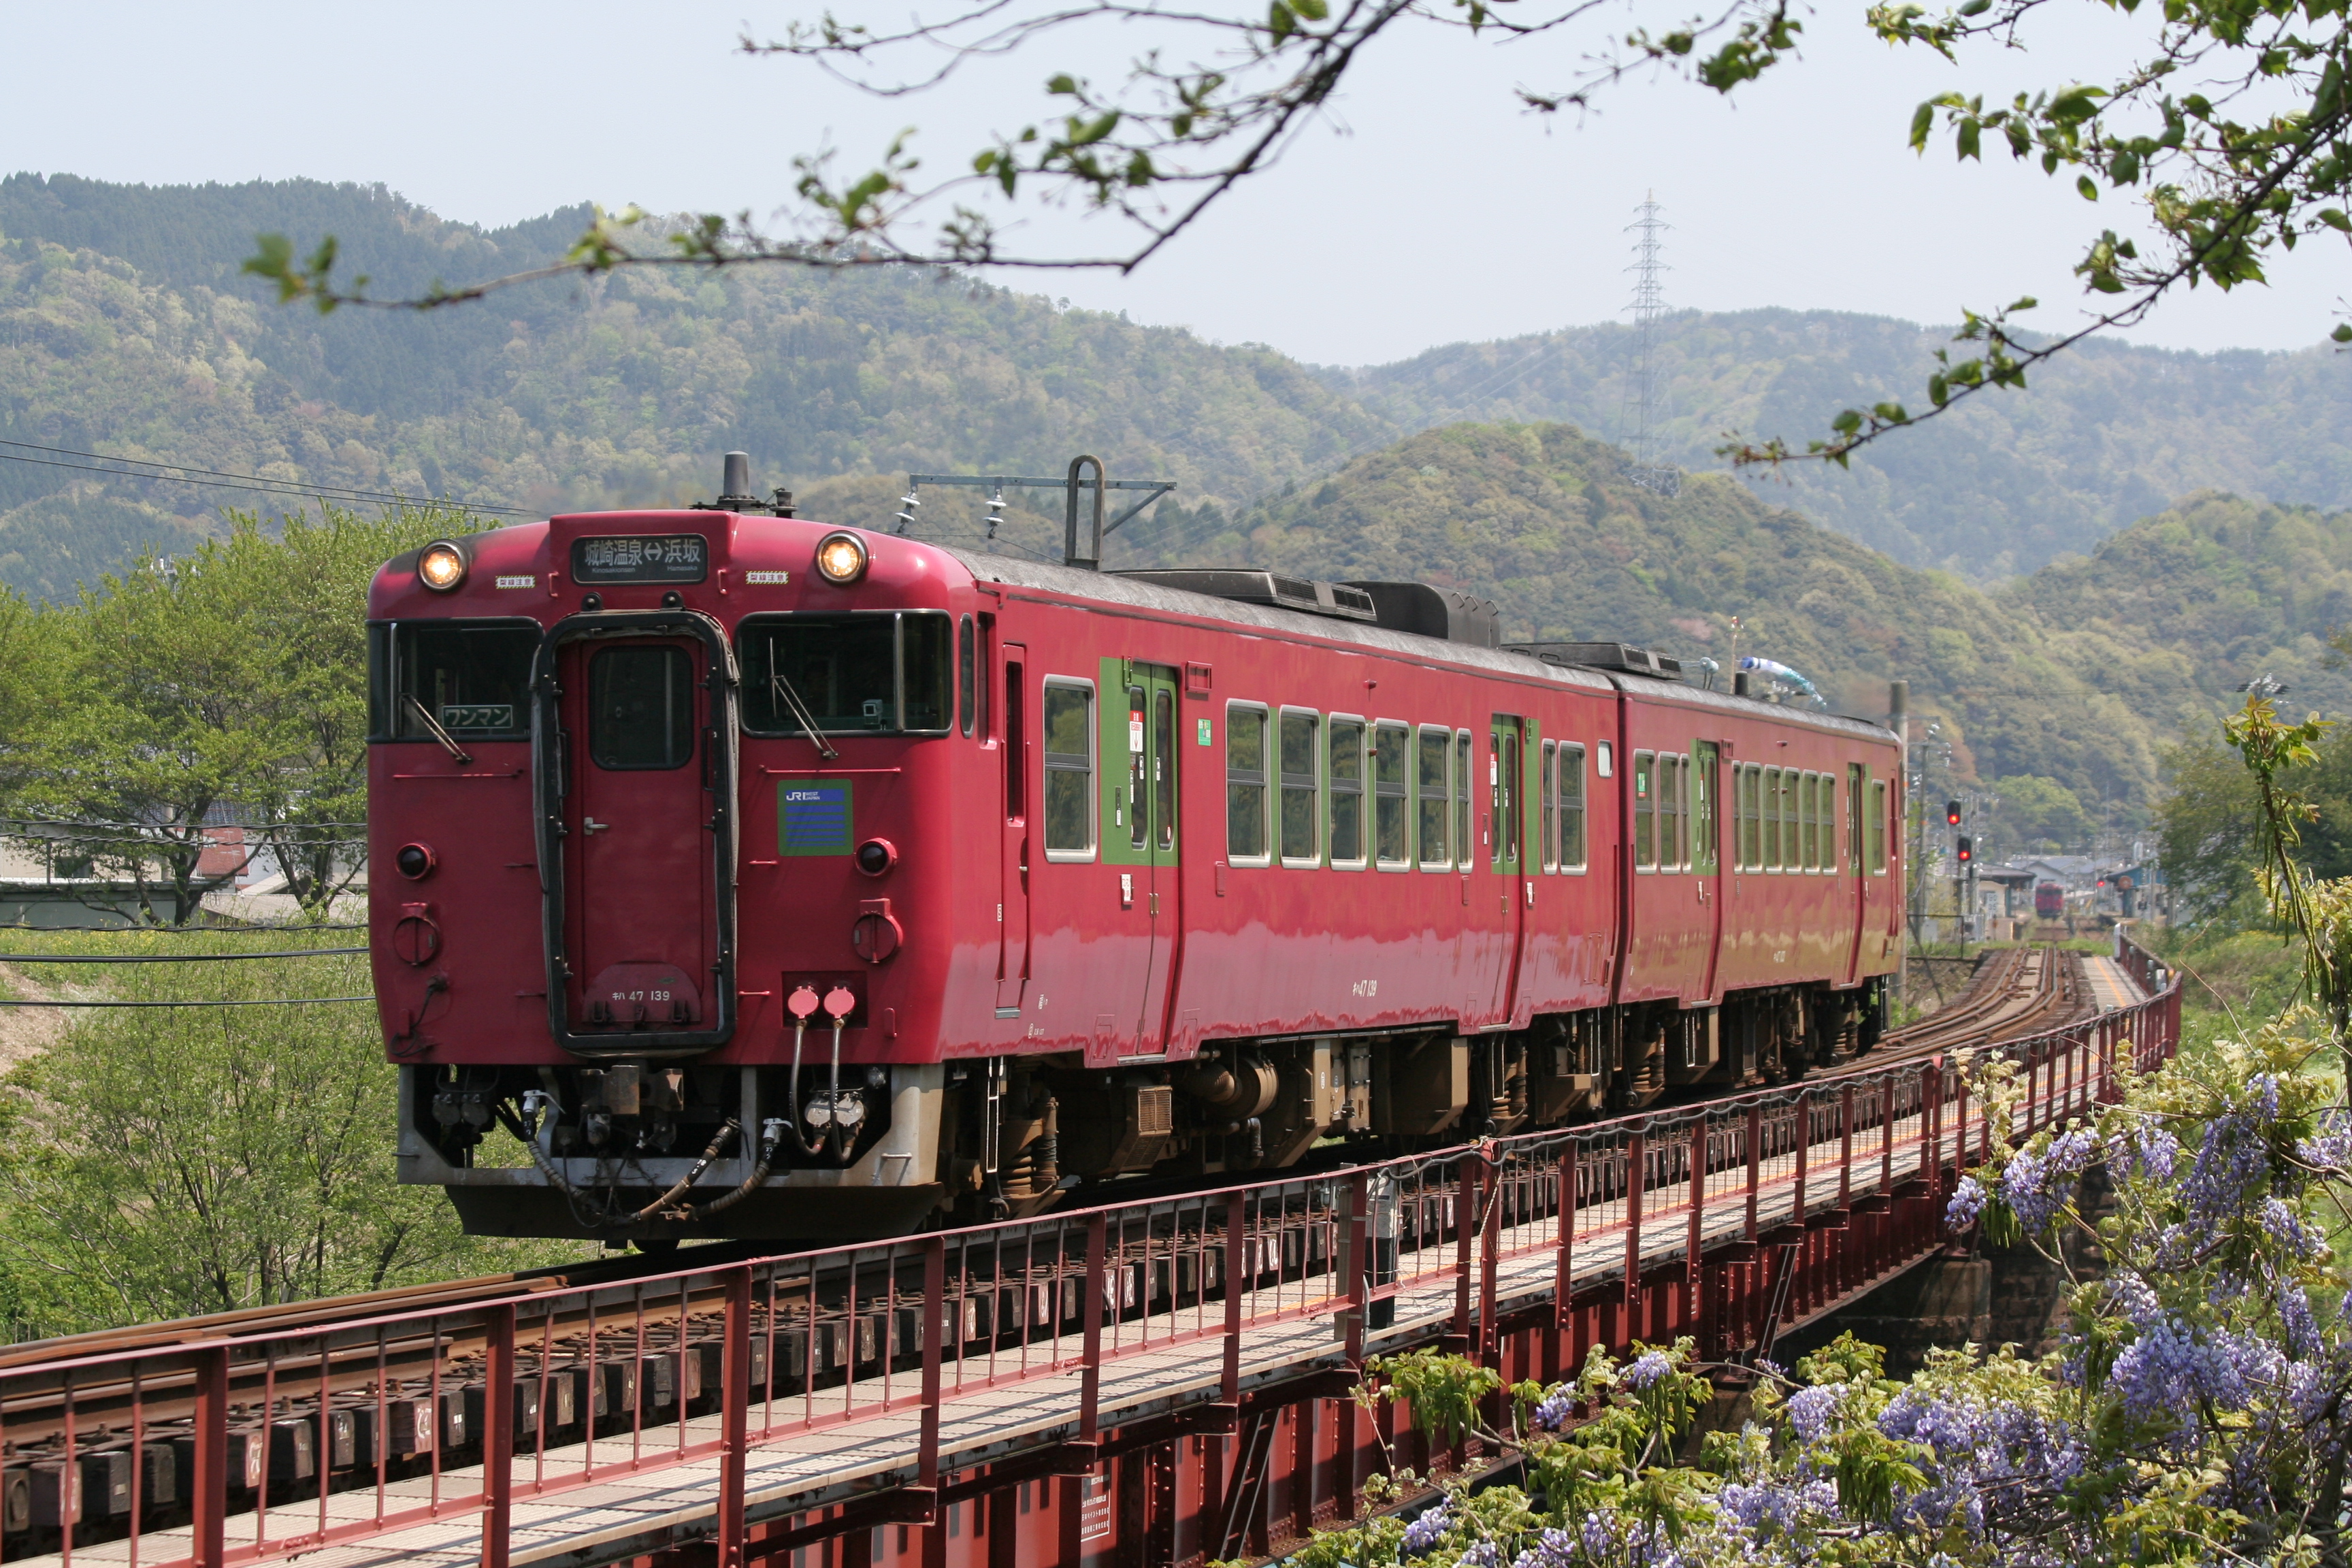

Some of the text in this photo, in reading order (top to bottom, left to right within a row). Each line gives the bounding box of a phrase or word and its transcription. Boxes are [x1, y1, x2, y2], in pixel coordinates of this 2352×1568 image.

[585, 538, 700, 566] 城崎温泉 浜坂
[444, 708, 510, 725] ワンマン
[786, 791, 802, 801] JR
[629, 991, 644, 1001] 47
[651, 990, 670, 1001] 139
